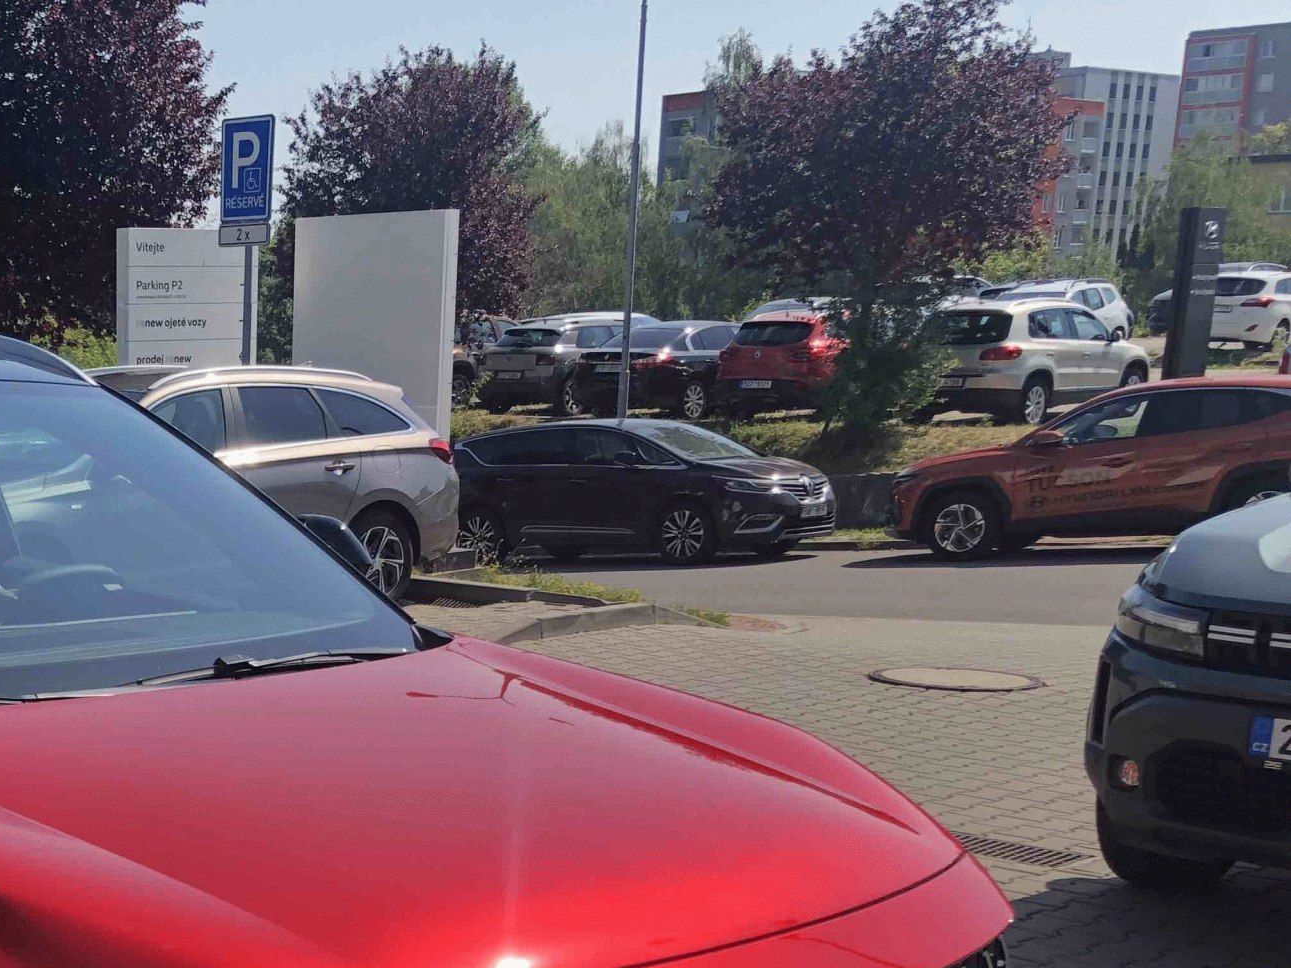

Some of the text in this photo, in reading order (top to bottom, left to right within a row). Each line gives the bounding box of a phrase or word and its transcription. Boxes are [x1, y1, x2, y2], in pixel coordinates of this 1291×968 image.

[232, 131, 260, 189] P
[236, 228, 243, 241] 2
[136, 280, 183, 292] Parking P2
[164, 317, 186, 329] ojeté
[187, 319, 207, 328] vozy
[136, 354, 164, 365] prodej
